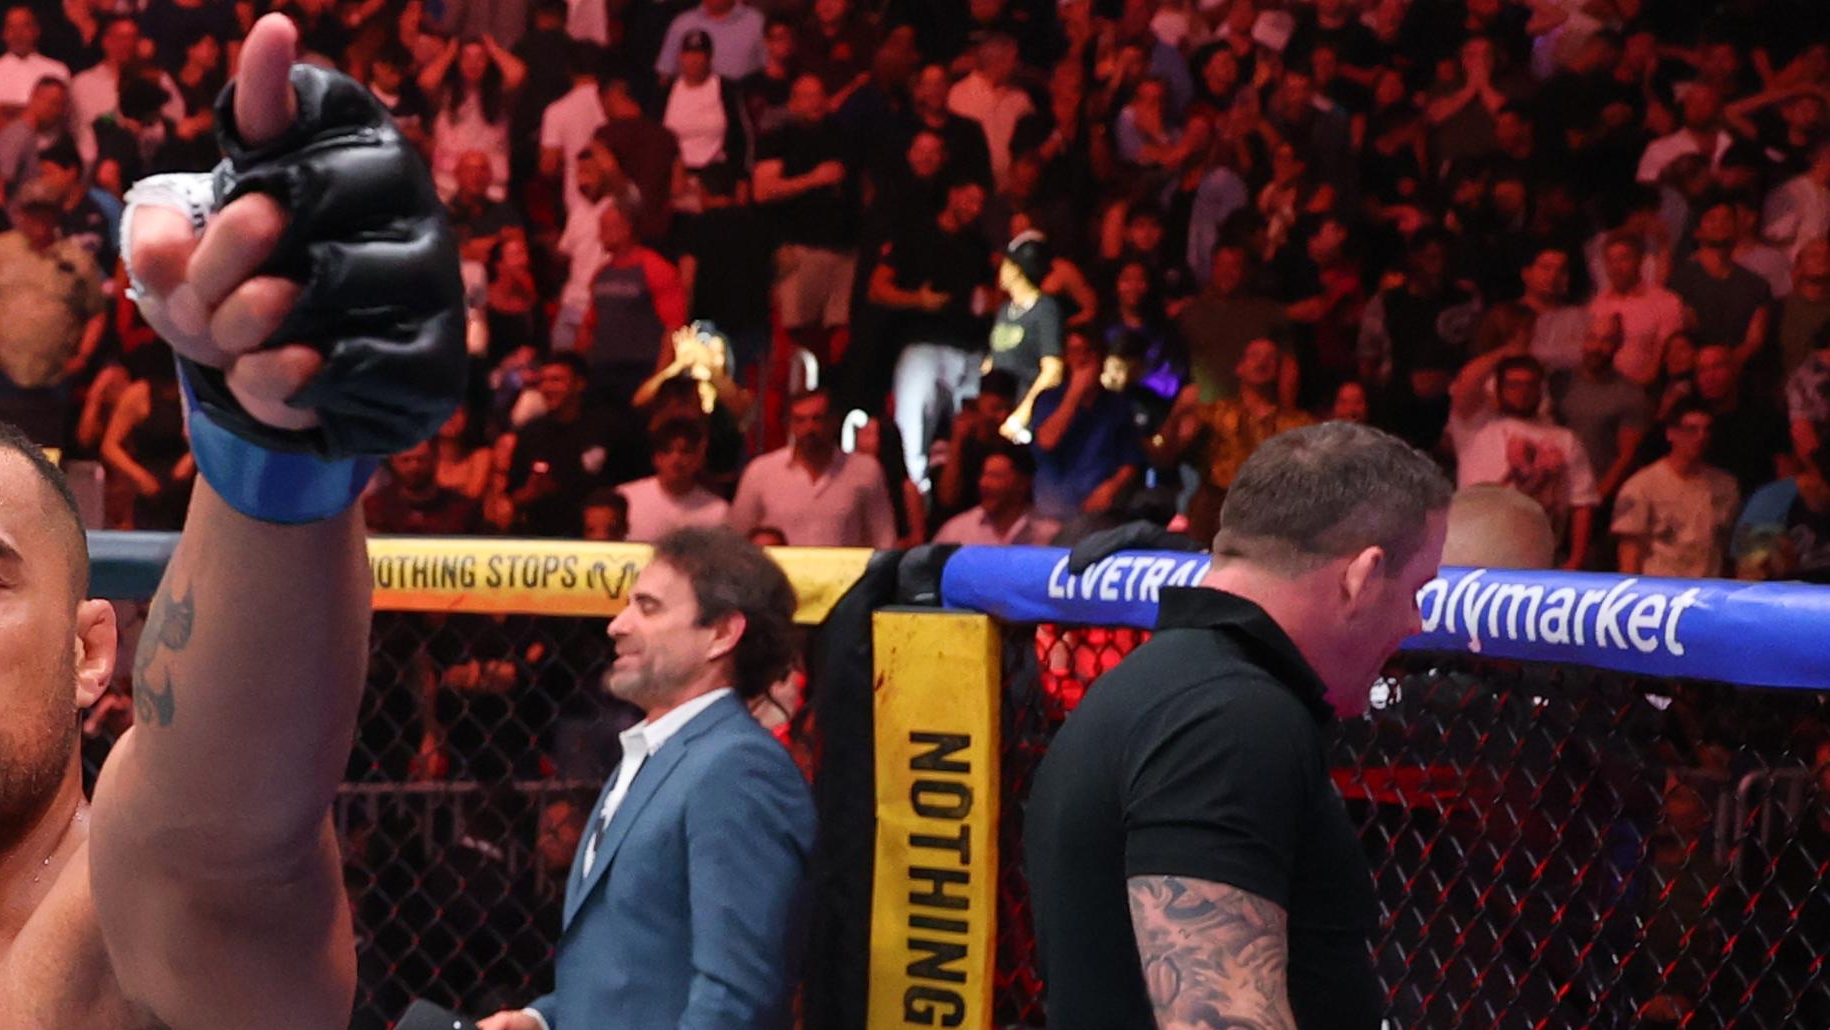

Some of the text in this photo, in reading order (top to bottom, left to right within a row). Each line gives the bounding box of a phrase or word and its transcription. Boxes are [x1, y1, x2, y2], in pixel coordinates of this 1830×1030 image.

[371, 554, 579, 590] OTHING STOPS
[1415, 569, 1702, 656] olymarket
[903, 730, 974, 1029] NOTHING
